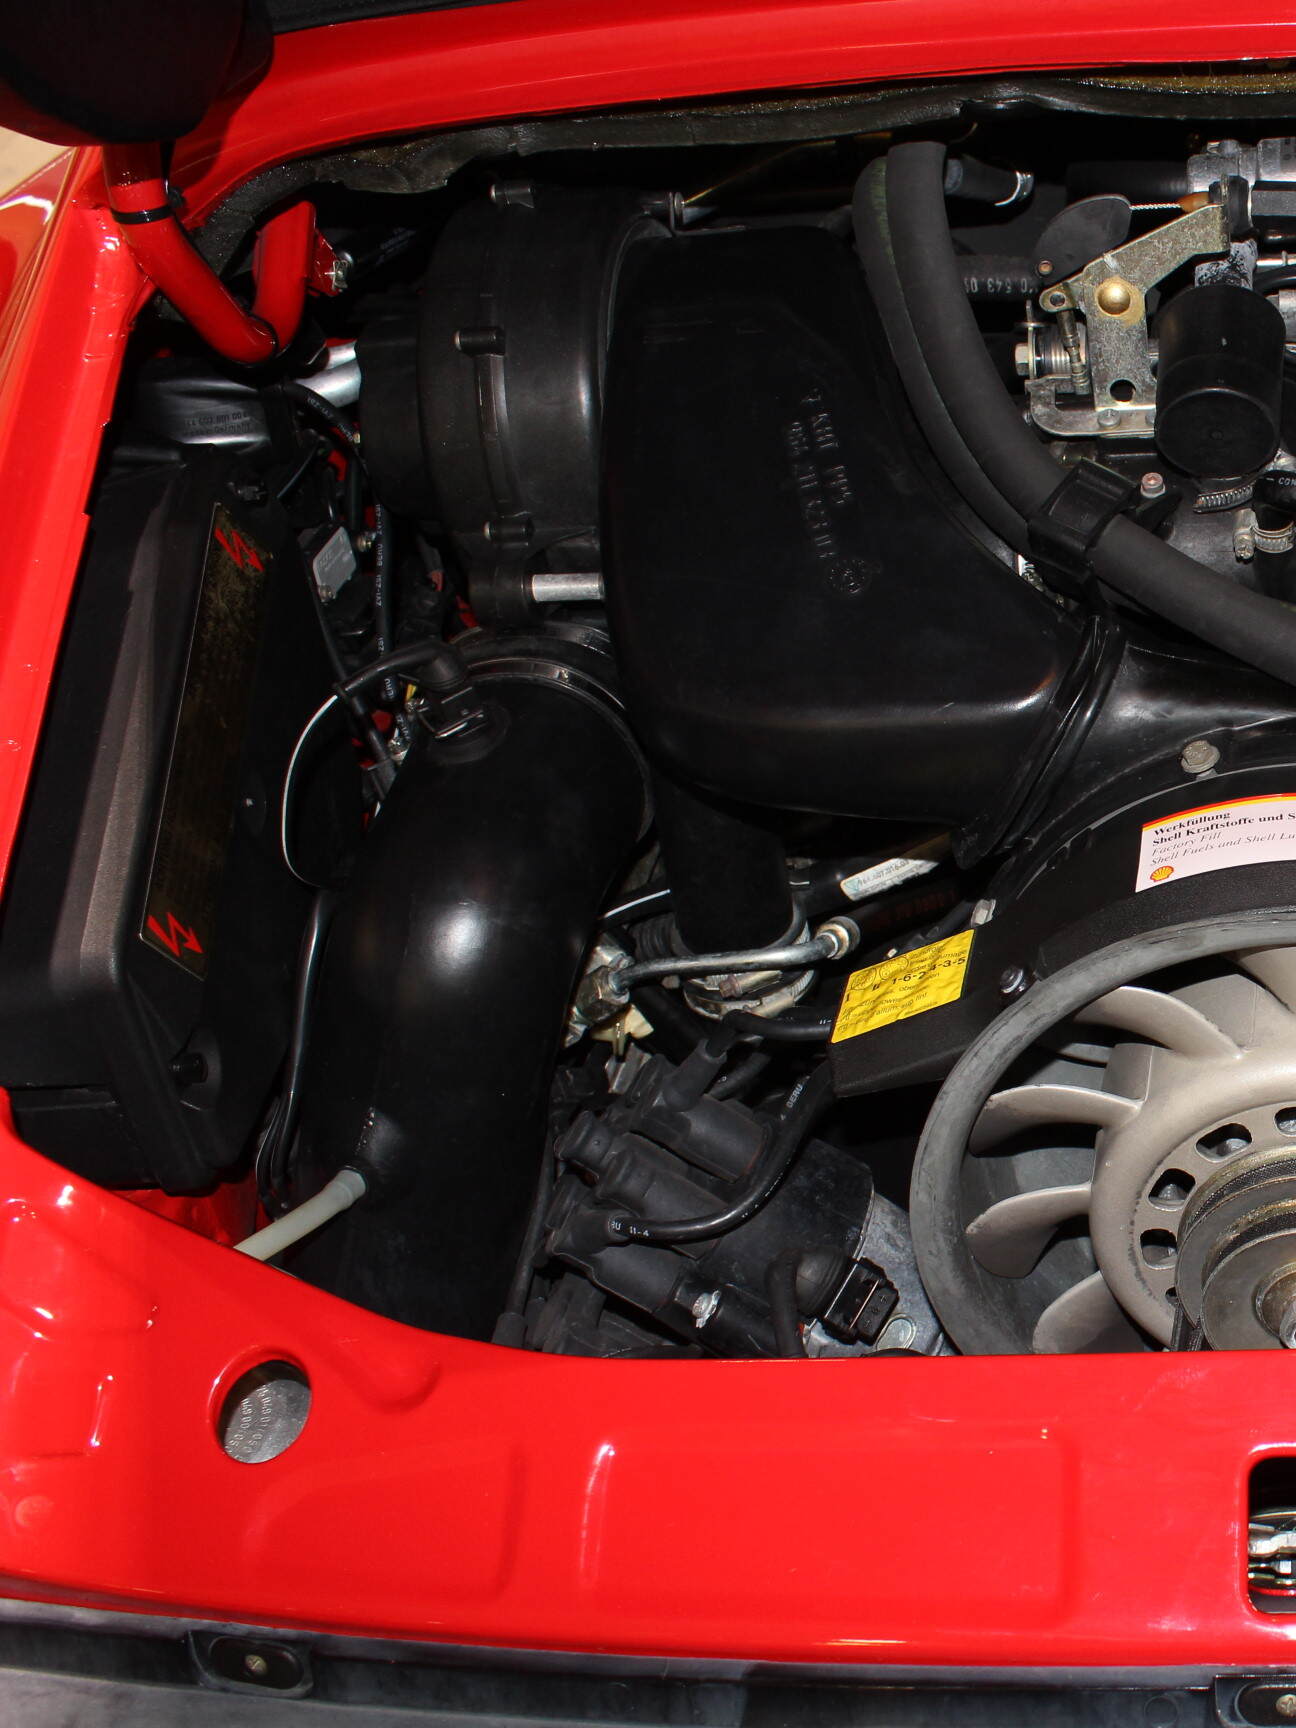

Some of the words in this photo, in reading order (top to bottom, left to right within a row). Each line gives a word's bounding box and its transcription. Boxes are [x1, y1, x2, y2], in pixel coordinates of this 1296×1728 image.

[1152, 832, 1182, 846] Shell
[1186, 817, 1254, 837] Kraftstoffe
[1259, 813, 1283, 823] und
[1154, 812, 1231, 836] Werkfüllung
[1151, 839, 1197, 857] Factory
[1200, 831, 1222, 842] Fill
[1151, 852, 1178, 866] Shell
[1182, 844, 1214, 857] Fuels
[1218, 836, 1241, 849] and
[1246, 833, 1276, 844] Shell
